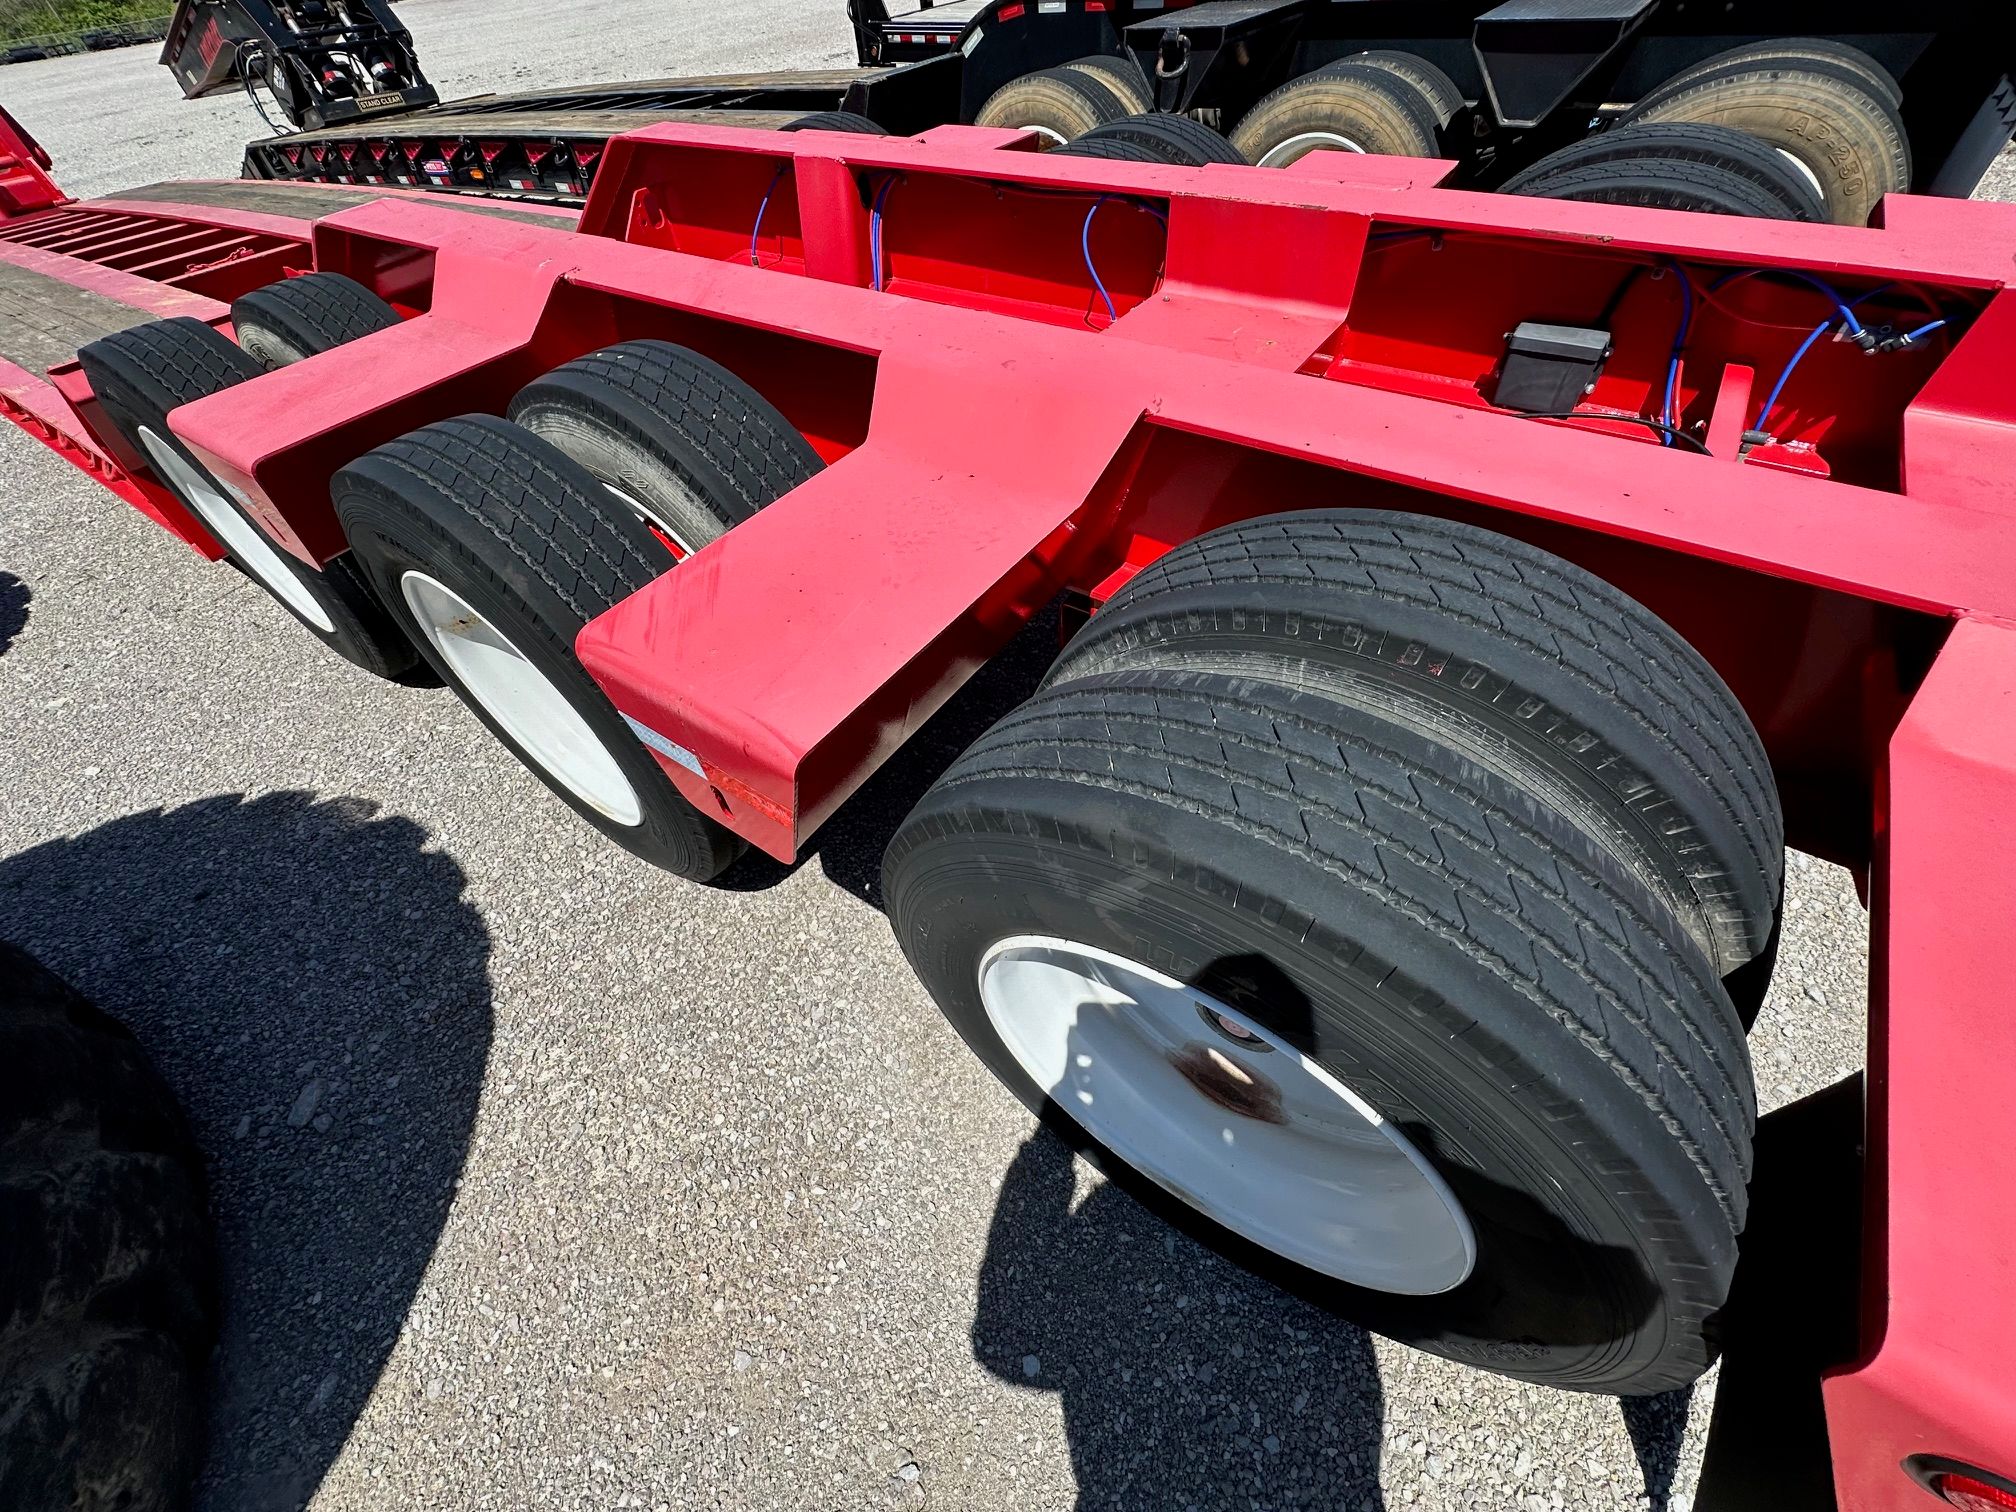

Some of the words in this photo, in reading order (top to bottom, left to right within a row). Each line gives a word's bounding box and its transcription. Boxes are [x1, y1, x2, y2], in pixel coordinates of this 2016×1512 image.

[360, 99, 380, 109] STAND
[380, 95, 401, 105] CLEAR
[1785, 114, 1864, 197] AP-250
